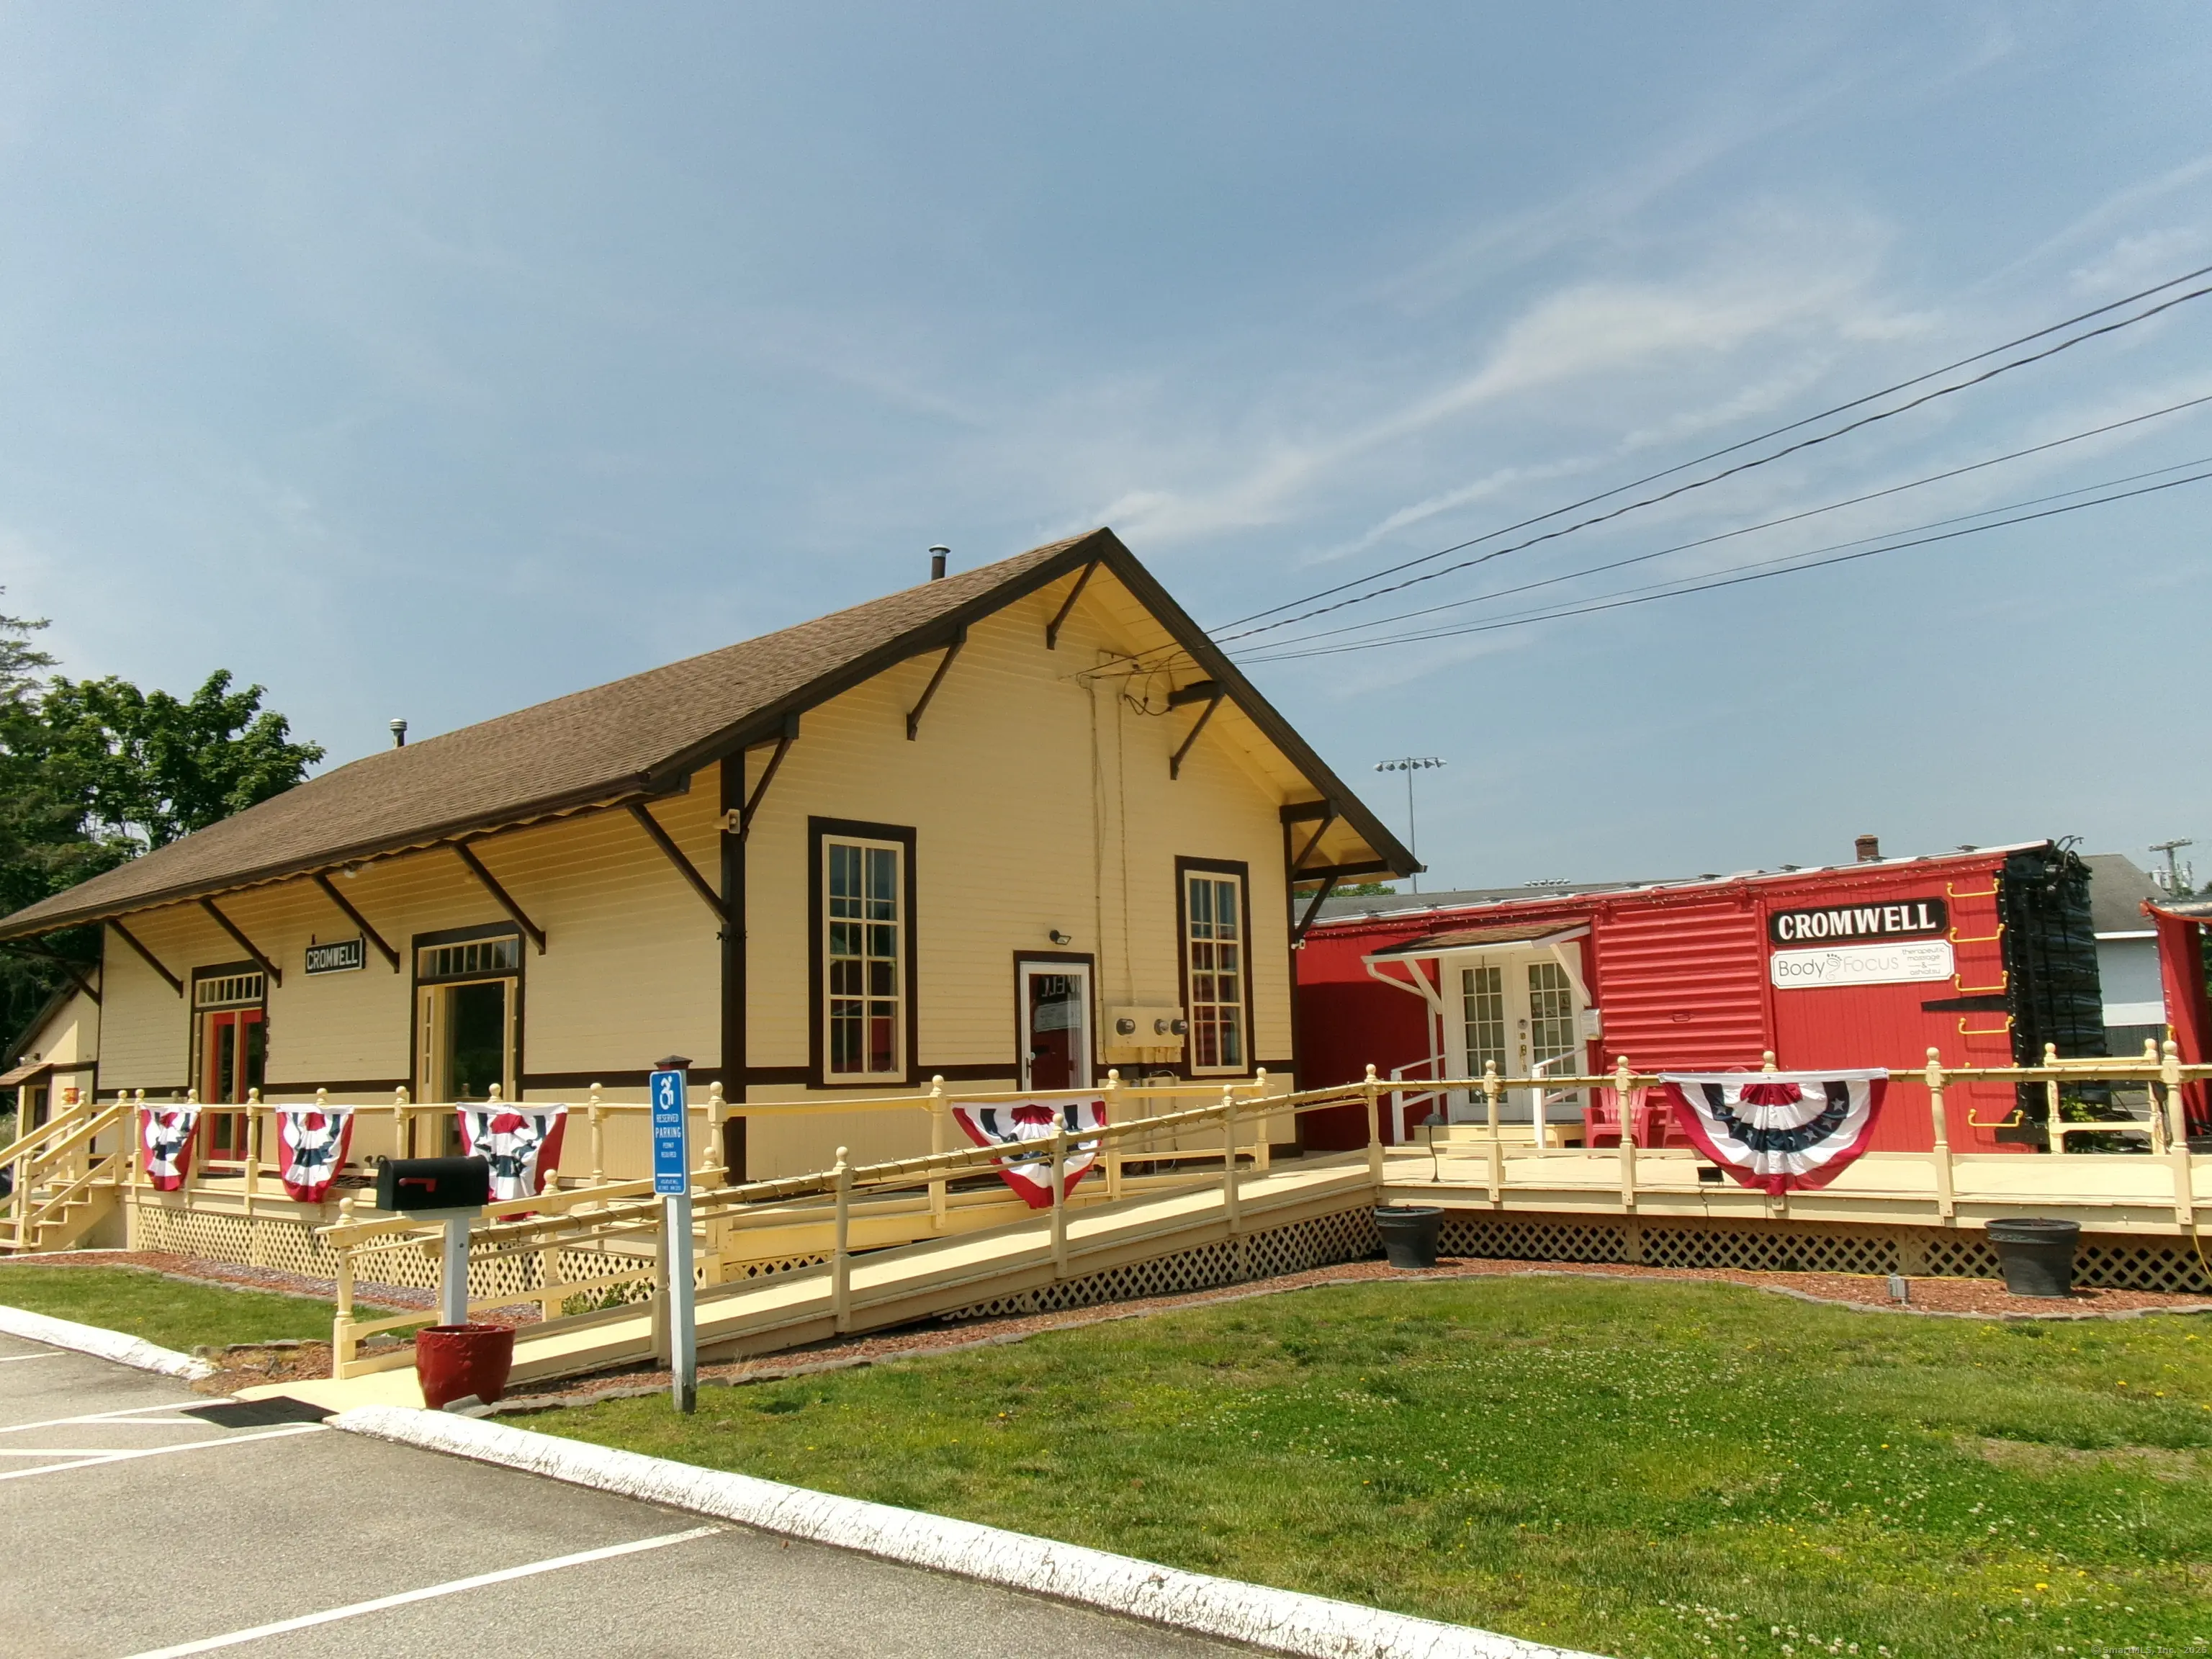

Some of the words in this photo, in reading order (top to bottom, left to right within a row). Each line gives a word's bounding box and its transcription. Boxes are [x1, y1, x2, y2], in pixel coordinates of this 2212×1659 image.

[1778, 903, 1937, 940] CROMWELL
[307, 945, 358, 970] CROMWELL
[1902, 947, 1945, 956] therapeutic
[1907, 954, 1941, 963] massage
[1778, 958, 1825, 979] Body
[1843, 956, 1899, 973] Focus
[656, 1113, 679, 1123] RESERVED
[655, 1126, 681, 1138] PARKING
